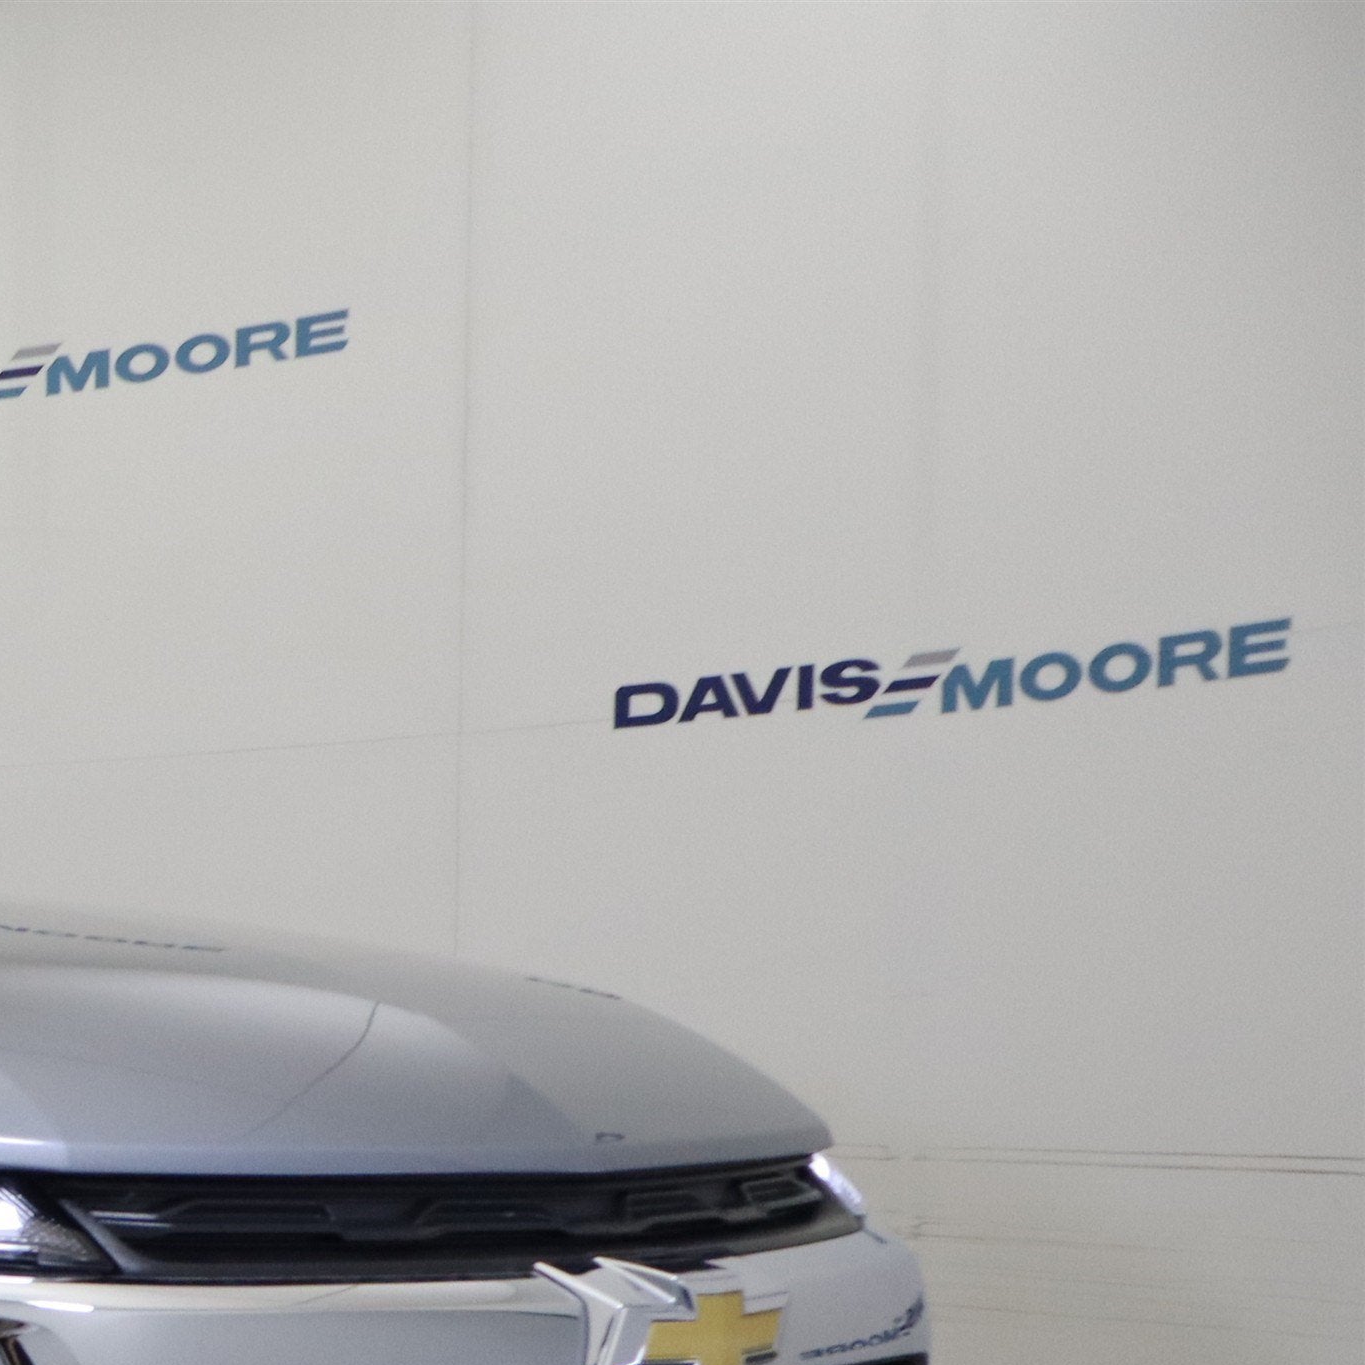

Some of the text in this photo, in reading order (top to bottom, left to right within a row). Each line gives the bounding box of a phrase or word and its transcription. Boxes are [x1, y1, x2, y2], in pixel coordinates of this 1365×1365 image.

[46, 309, 350, 397] MOORE
[614, 616, 1292, 729] DAVIS MOORE
